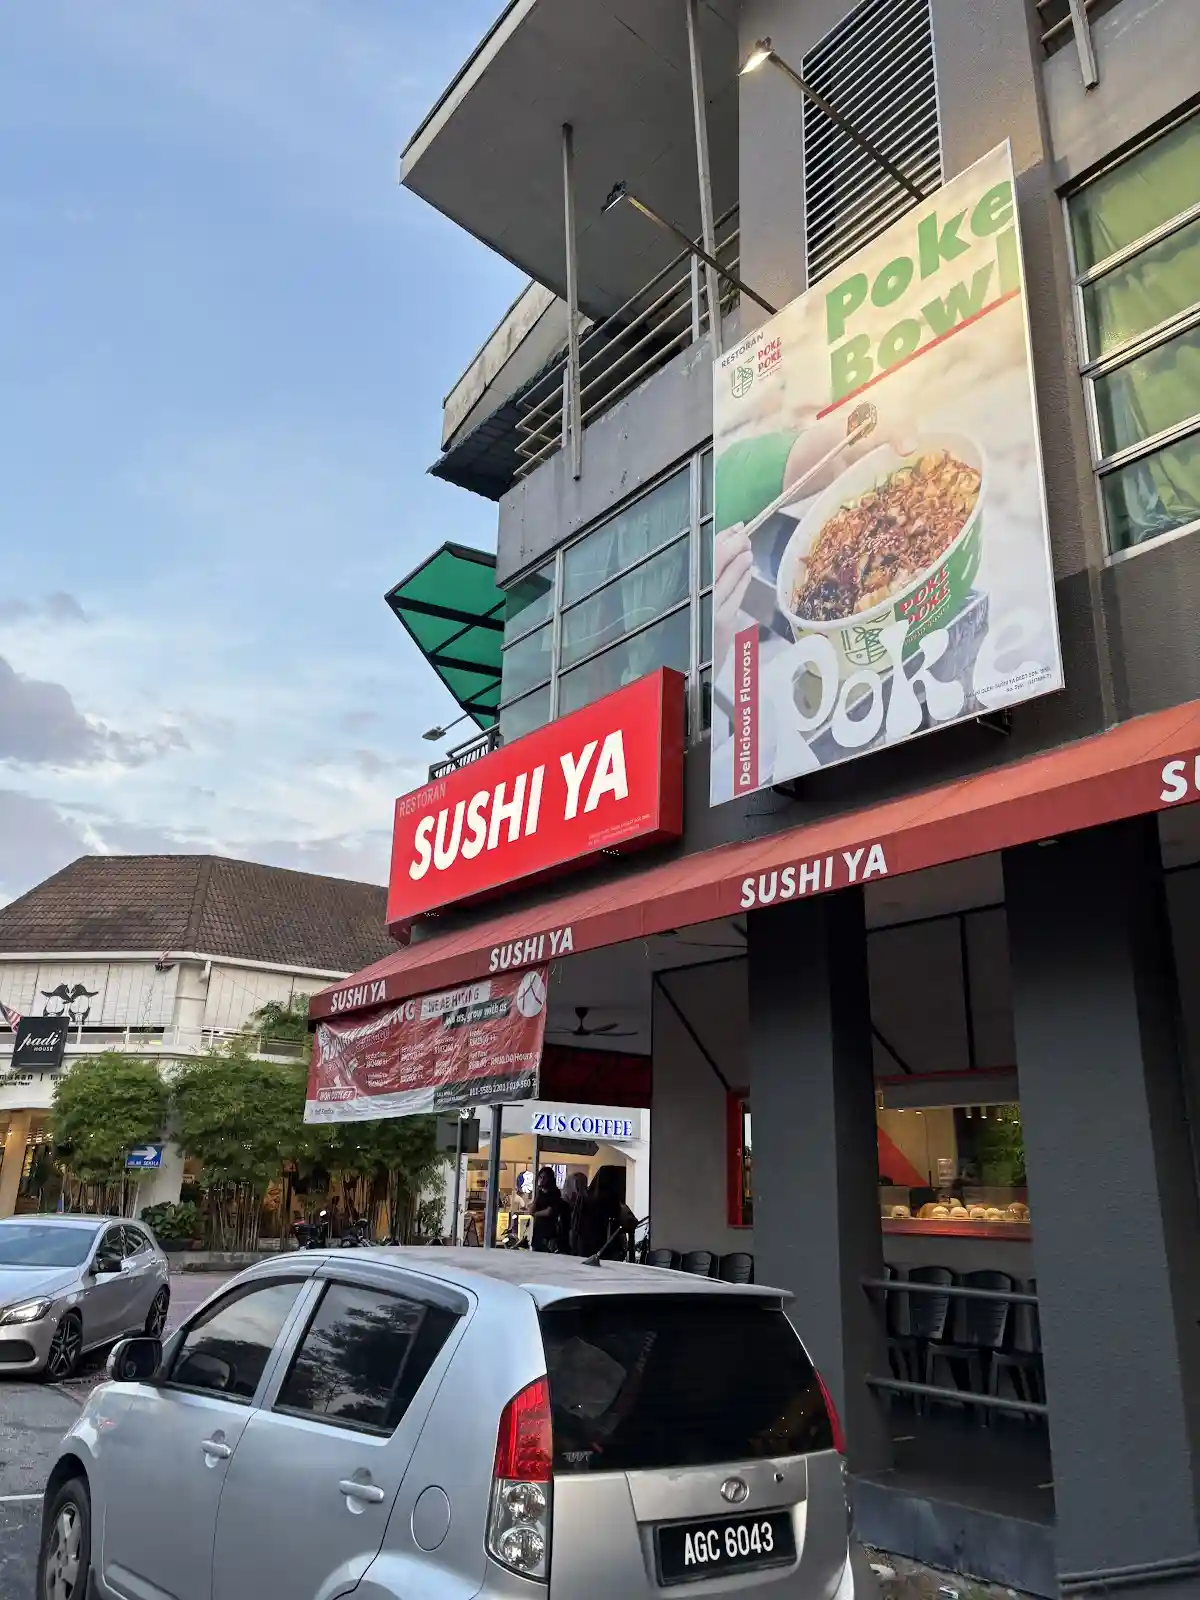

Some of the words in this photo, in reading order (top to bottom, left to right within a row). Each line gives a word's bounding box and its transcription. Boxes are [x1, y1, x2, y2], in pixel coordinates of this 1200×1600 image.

[825, 180, 1014, 345] Poke
[829, 225, 1021, 404] Bowl
[721, 332, 764, 368] RESTORAN
[757, 337, 782, 360] POKE
[739, 640, 752, 703] Flavors
[739, 706, 752, 786] Delicious
[400, 783, 447, 818] RESTORAN
[1160, 755, 1200, 802] S
[408, 764, 545, 881] SUSHI
[559, 729, 628, 821] YA
[740, 856, 834, 909] SUSHI
[842, 843, 888, 882] YA
[489, 932, 544, 973] SUSHI
[550, 927, 574, 954] YA
[330, 984, 369, 1012] SUSHI
[371, 980, 386, 1002] YA
[17, 1031, 60, 1051] padi
[533, 1113, 566, 1133] ZUS
[570, 1116, 632, 1137] COFFEE
[684, 1530, 720, 1565] AGC
[724, 1521, 774, 1558] 6043
